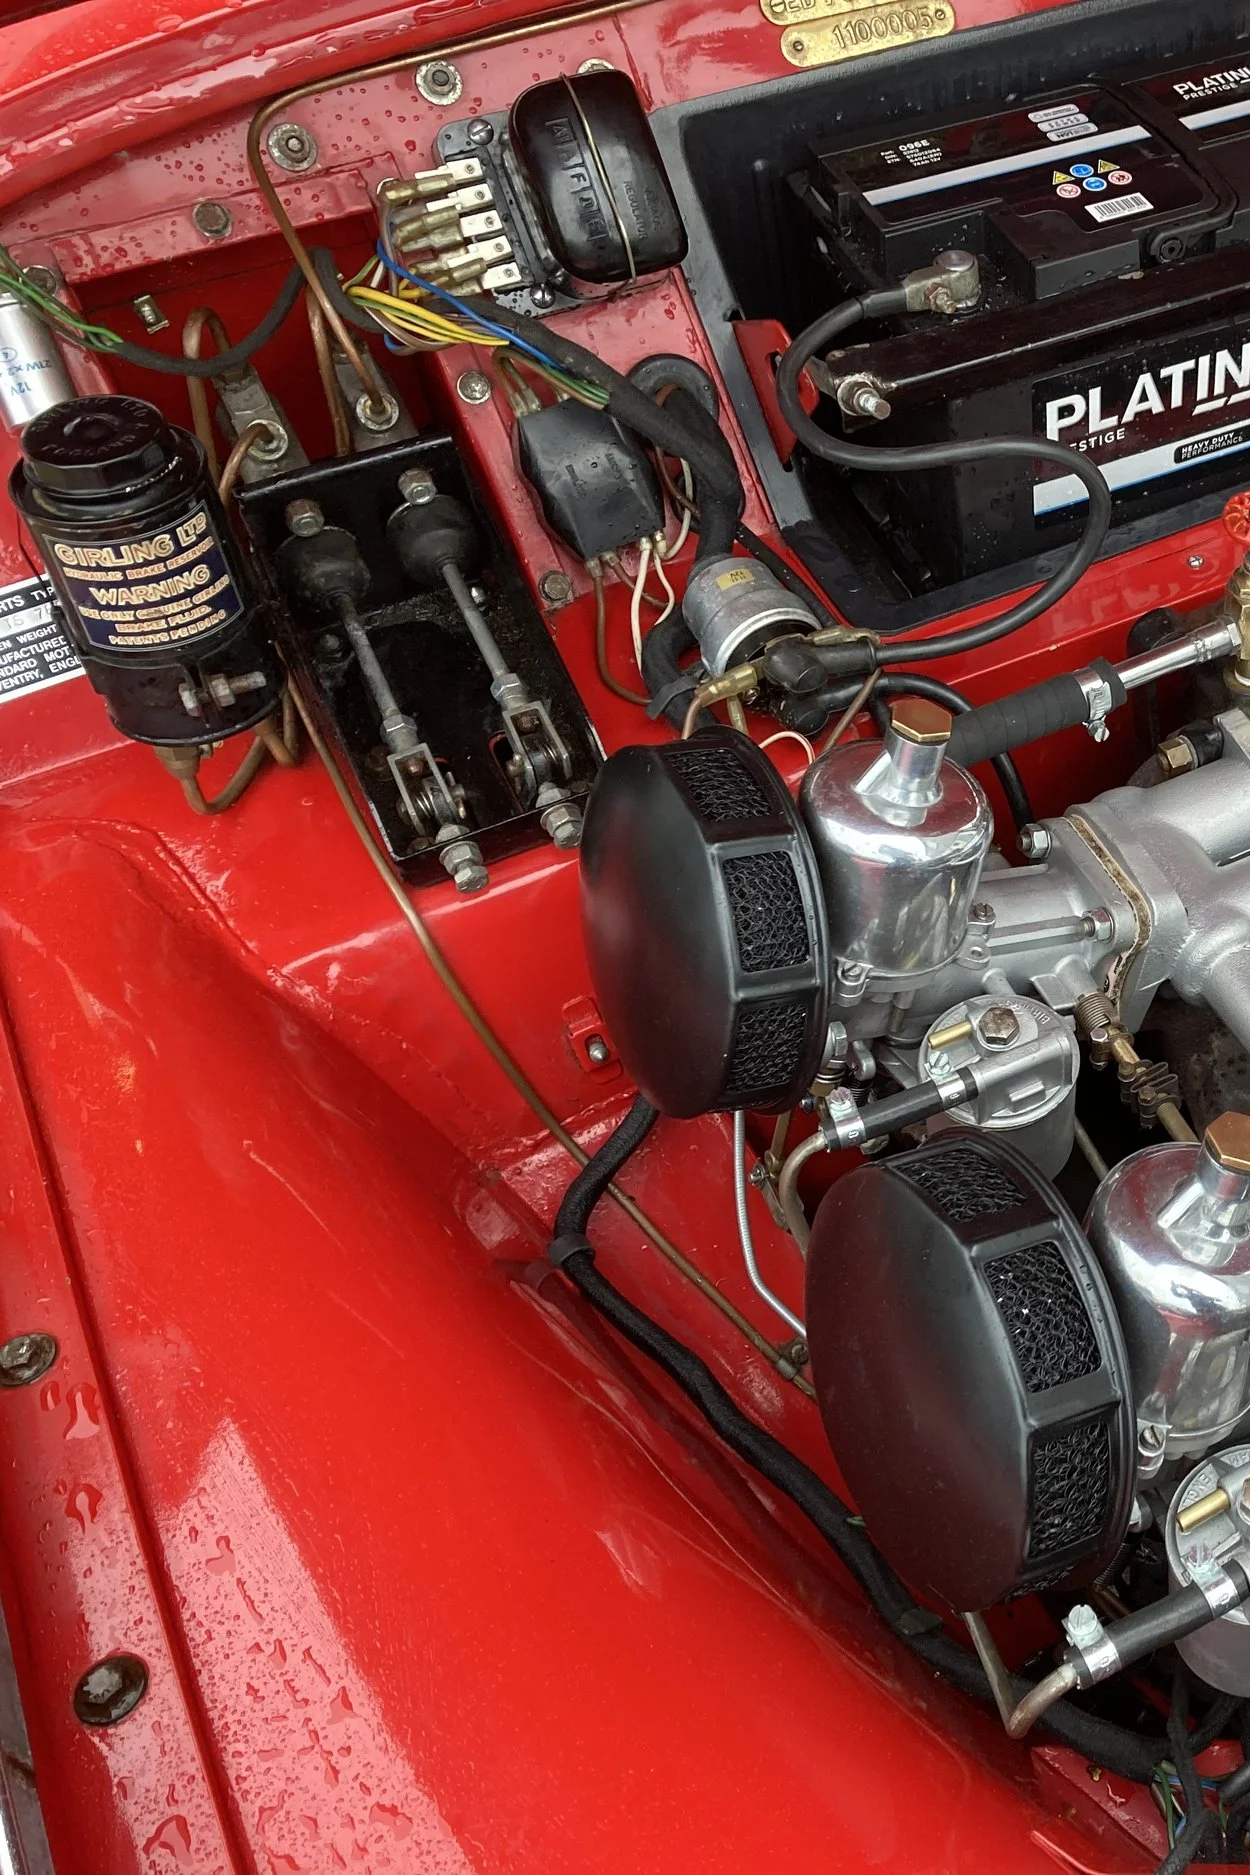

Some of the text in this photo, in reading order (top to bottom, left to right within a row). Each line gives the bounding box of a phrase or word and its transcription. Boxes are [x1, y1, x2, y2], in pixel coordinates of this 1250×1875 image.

[832, 6, 933, 49] 1100005
[1183, 83, 1239, 100] PRESTIGE
[623, 180, 649, 240] REGULATOR
[10, 381, 32, 396] 12V
[1181, 435, 1243, 460] PERFORMANCE
[1182, 432, 1235, 454] HEAVY DUTY
[54, 511, 207, 568] GIRLING LTD
[63, 536, 215, 582] HYDRAULIC BRAKE RESERVOIR
[89, 564, 210, 606] WARNING
[100, 609, 135, 622] ONLY
[136, 598, 192, 621] GENUINE
[192, 574, 230, 605] GIRLING
[16, 624, 57, 644] WEIGHT
[109, 609, 227, 645] PATENTS PENDING
[115, 619, 167, 633] BRAKE
